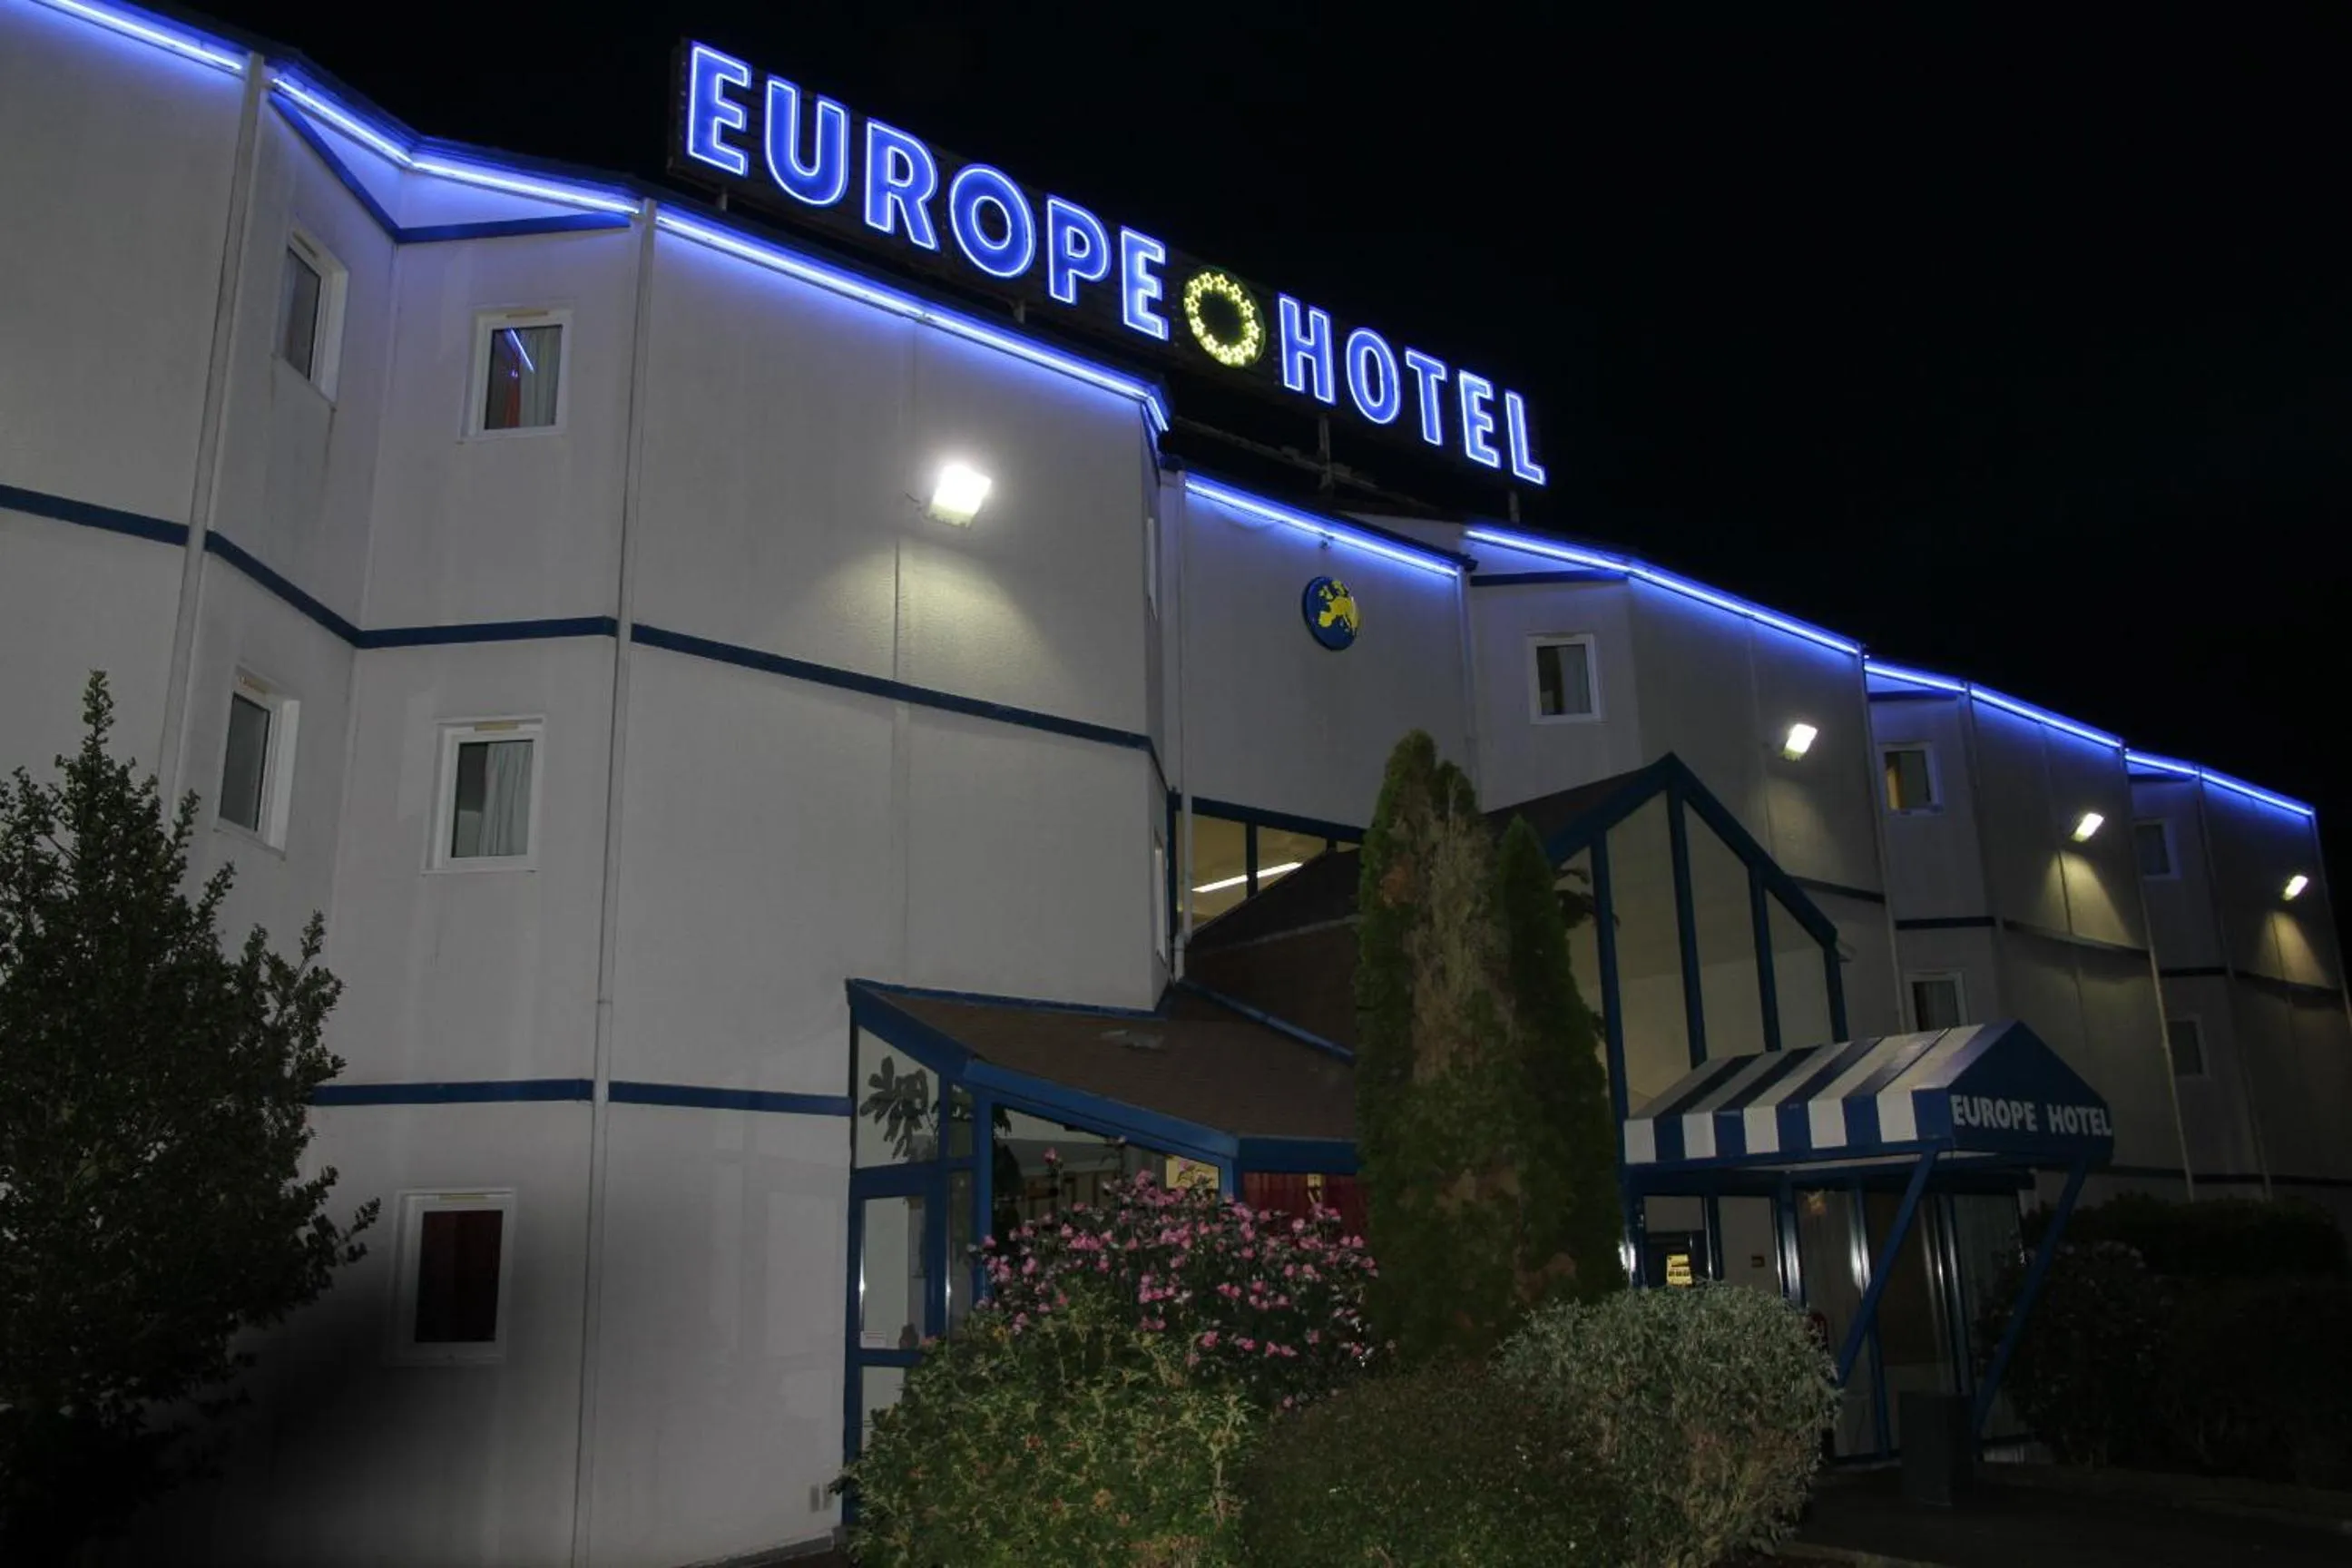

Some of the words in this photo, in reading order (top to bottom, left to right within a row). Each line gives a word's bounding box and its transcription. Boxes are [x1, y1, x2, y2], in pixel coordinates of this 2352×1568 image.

[686, 40, 1170, 341] EUROPE
[1277, 292, 1546, 486] HOTEL
[1951, 1094, 2038, 1132] EUROPE
[2046, 1102, 2112, 1136] HOTEL
